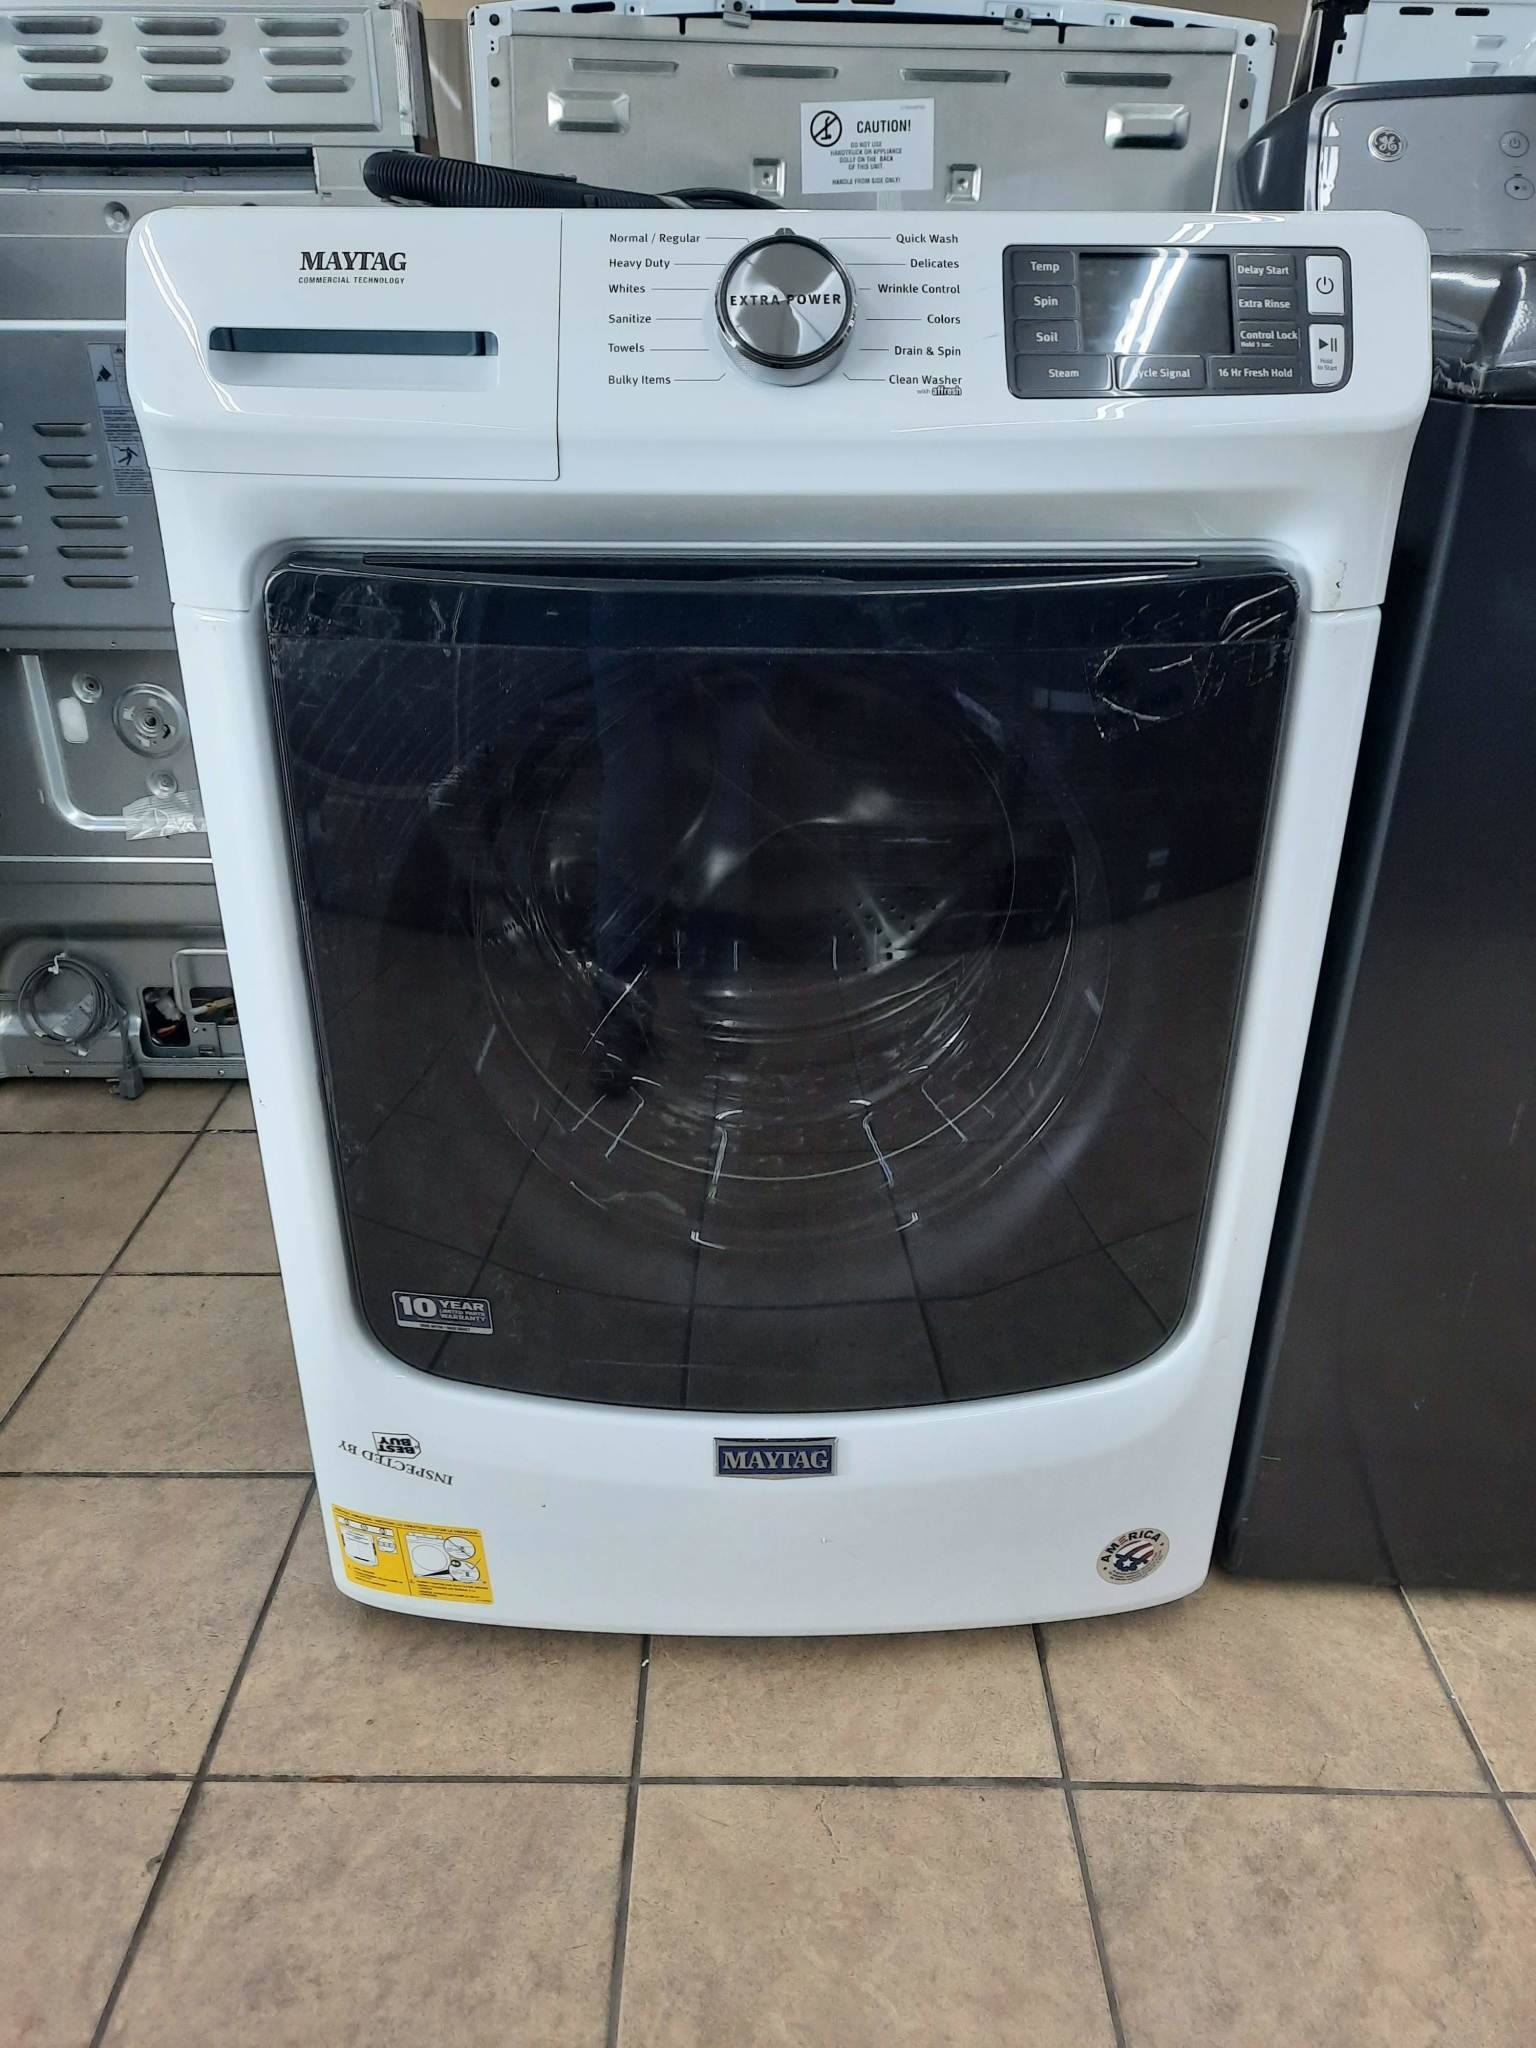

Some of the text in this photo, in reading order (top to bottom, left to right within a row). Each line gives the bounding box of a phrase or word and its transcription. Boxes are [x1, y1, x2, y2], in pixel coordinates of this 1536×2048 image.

[856, 119, 912, 133] CAUTION!
[609, 233, 648, 243] Normal
[659, 233, 701, 245] Regular
[896, 233, 959, 244] Quick Wash
[299, 251, 407, 271] MAYTAG
[609, 258, 671, 270] Heavy Duty
[910, 258, 960, 269] Delicates
[1030, 261, 1060, 274] Temp
[1237, 265, 1290, 276] Delay Start
[298, 276, 405, 284] COMMERCIAL TECHNOLOGY
[608, 283, 646, 294] Whites
[877, 283, 961, 294] Wrinkle Control
[730, 293, 842, 306] EXTRA POWER
[1033, 295, 1059, 308] Spin
[1238, 299, 1291, 309] Extra Rinse
[608, 313, 652, 324] Sanitize
[927, 314, 961, 324] Colors
[1035, 331, 1059, 342] Soil
[1240, 330, 1298, 340] Control Lock
[608, 343, 645, 353] Towels
[894, 345, 961, 358] Drain & Spin
[1048, 368, 1080, 378] Steam
[1160, 368, 1191, 379] Signal
[1218, 368, 1293, 377] 16 Hr Fresh Hold
[608, 374, 671, 387] Bulky Items
[888, 374, 962, 385] Clean Washer
[398, 1295, 485, 1318] 10 YEAR
[379, 1435, 412, 1447] BUY
[378, 1444, 416, 1455] BEST
[337, 1439, 454, 1486] INSPECTED BY
[722, 1449, 829, 1469] MAYTAG
